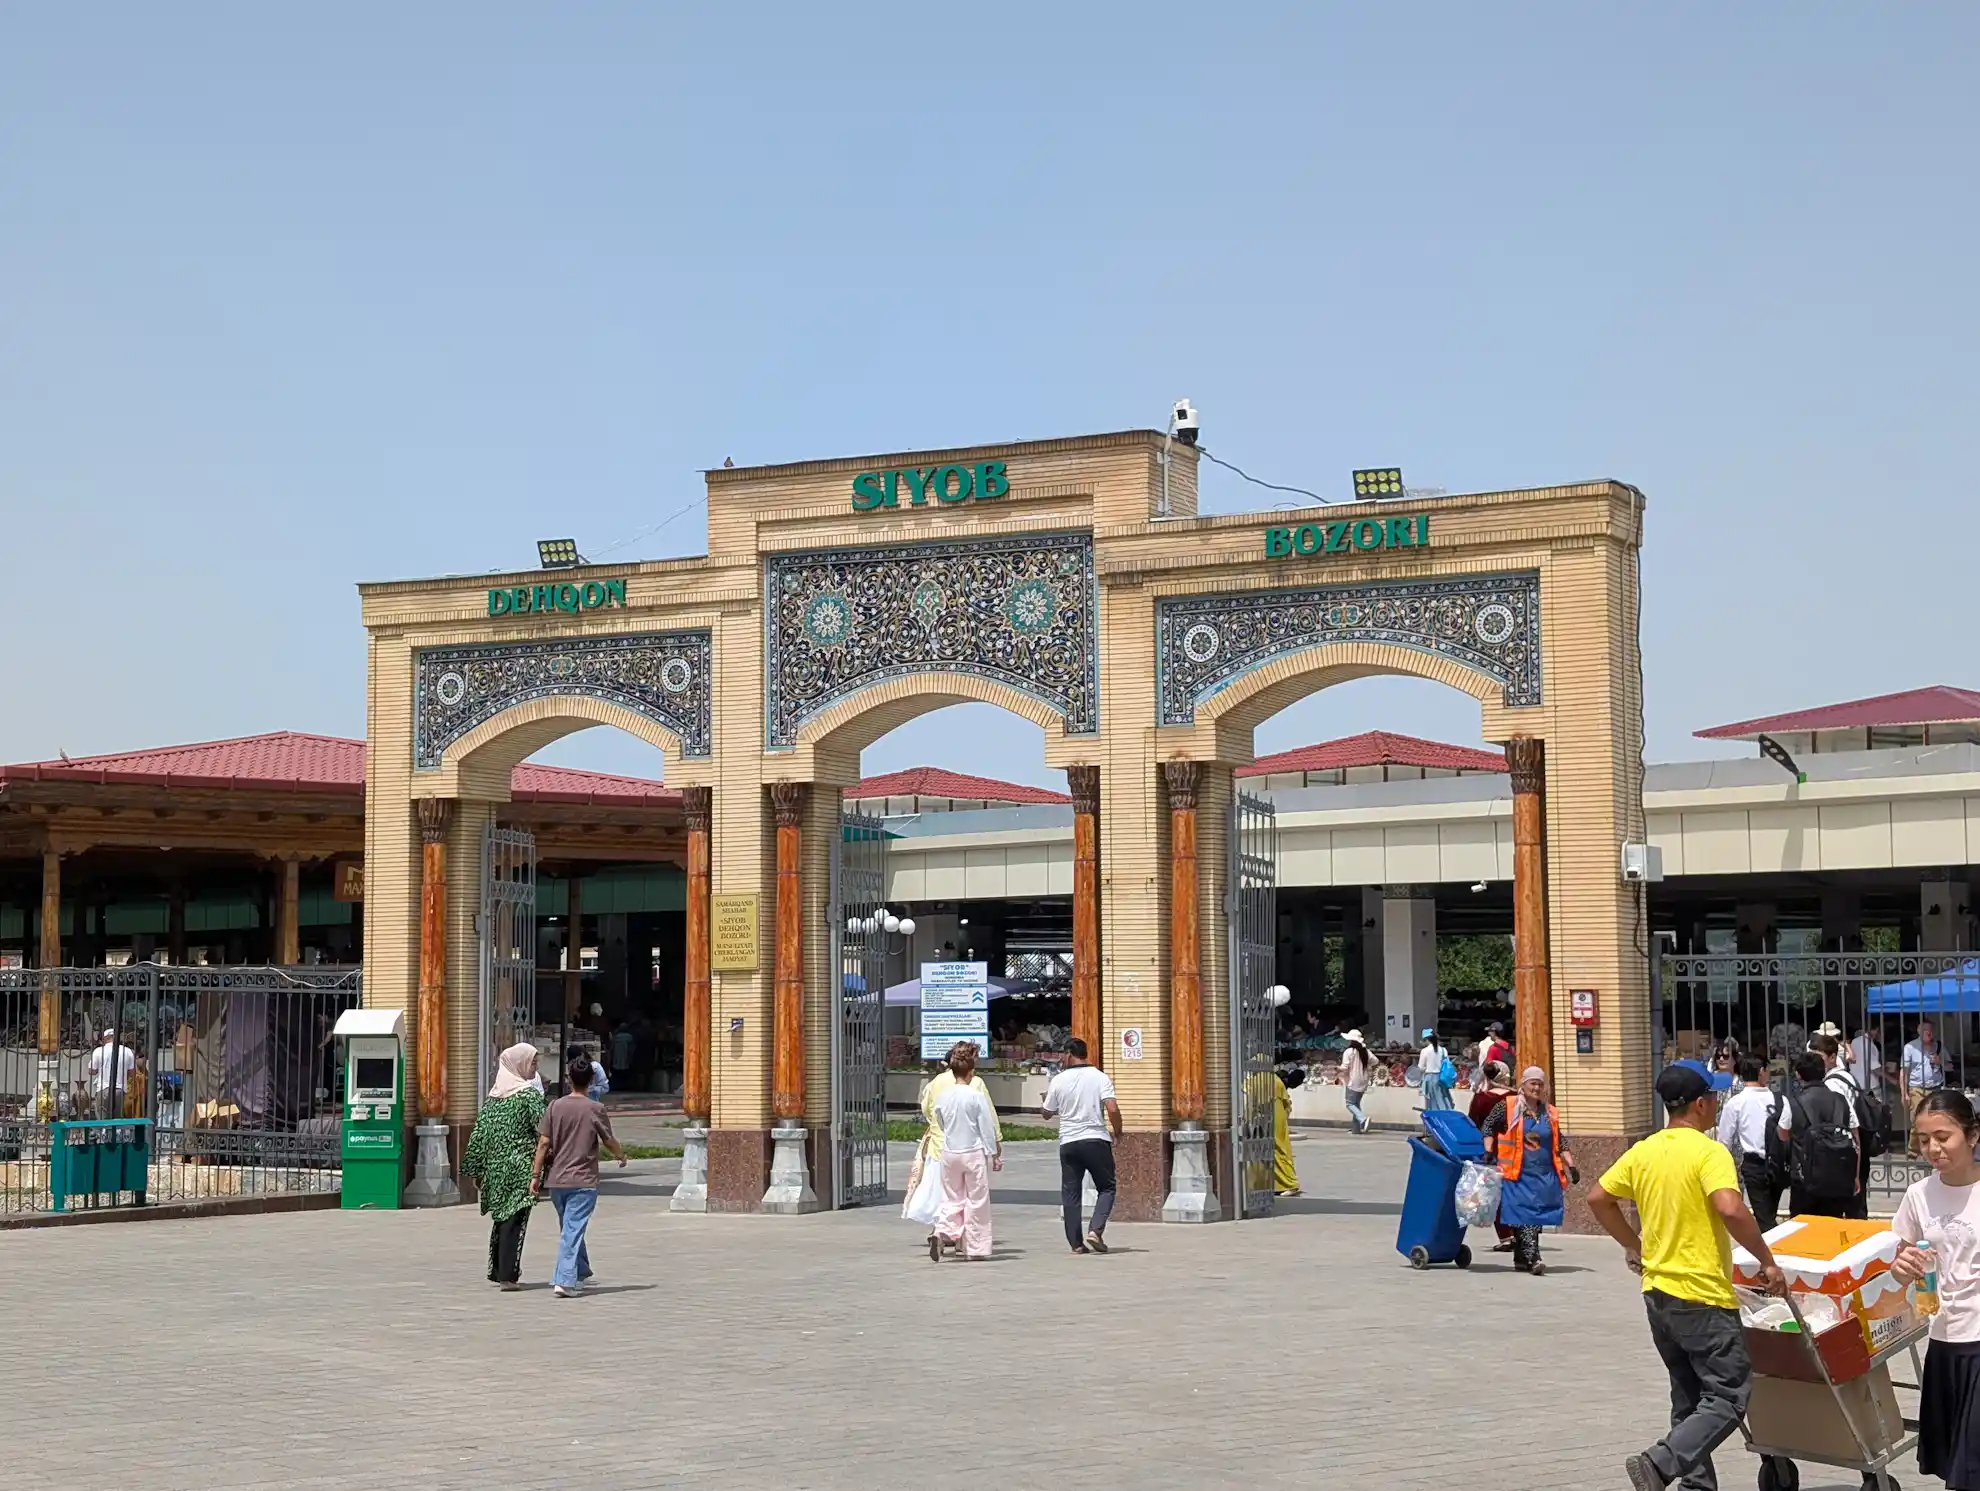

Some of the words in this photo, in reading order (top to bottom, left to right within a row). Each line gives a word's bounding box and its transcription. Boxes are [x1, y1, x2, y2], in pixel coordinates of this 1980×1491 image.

[852, 460, 1010, 510] SIYOB
[1265, 515, 1429, 558] BOZORI
[488, 580, 626, 616] DEHQON
[718, 924, 751, 933] DEHQON
[1123, 1049, 1141, 1057] 1215
[1872, 1316, 1903, 1338] ndijon
